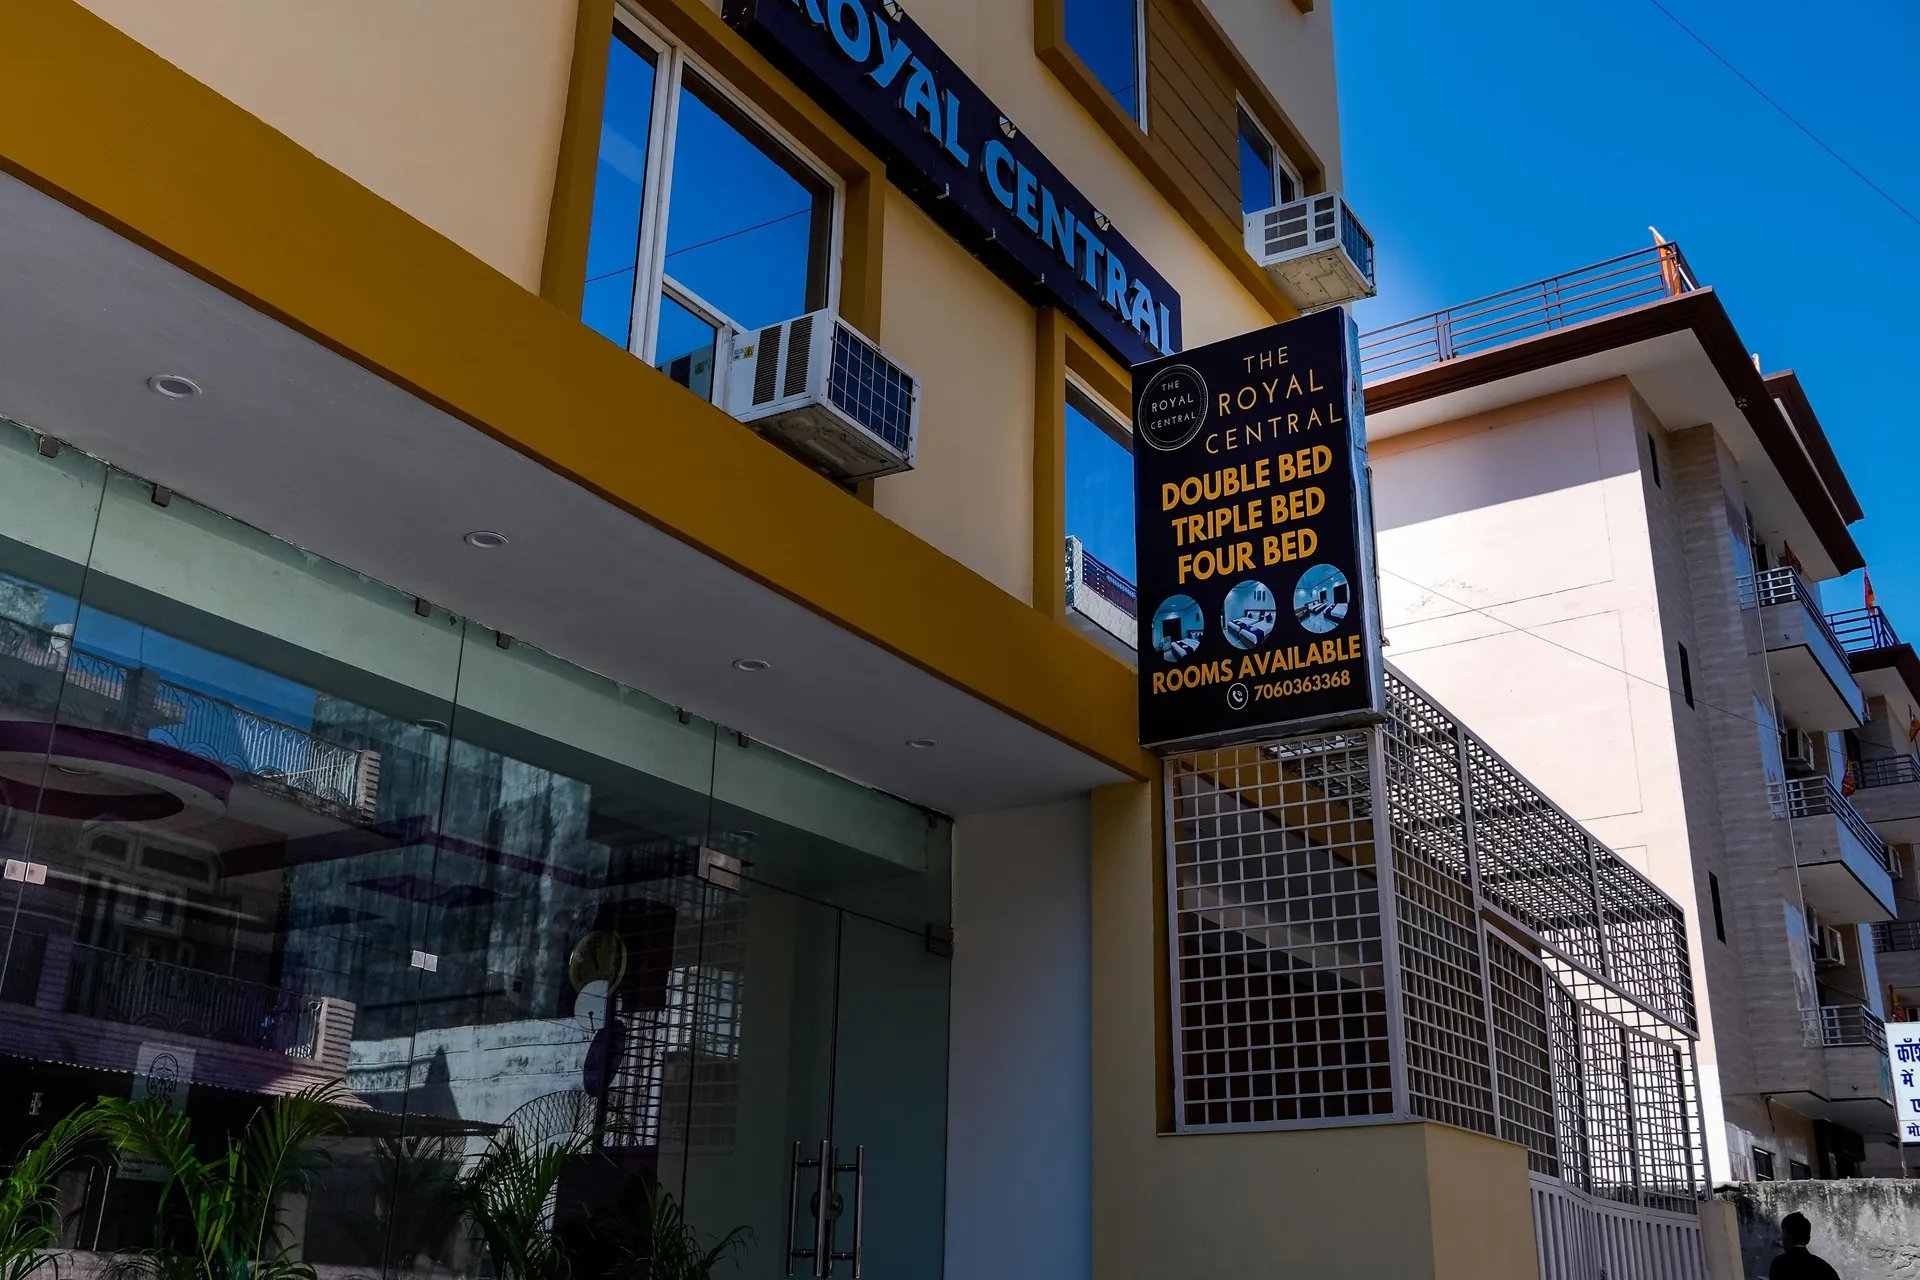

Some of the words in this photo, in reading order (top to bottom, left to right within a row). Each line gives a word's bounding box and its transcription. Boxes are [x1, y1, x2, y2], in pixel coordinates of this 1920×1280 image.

[984, 139, 1175, 357] CENTRAL
[1243, 345, 1288, 373] THE
[1151, 393, 1194, 413] ROYAL
[1161, 380, 1180, 391] THE
[1218, 368, 1324, 417] ROYAL
[1150, 411, 1197, 430] CENTRAL
[1205, 402, 1342, 454] CENTRAL
[1162, 458, 1271, 512] DOUBLE
[1278, 445, 1333, 483] BED
[1171, 499, 1263, 547] TRIPLE
[1271, 486, 1326, 525] BED
[1178, 541, 1257, 585] FOUR
[1263, 528, 1318, 567] BED
[1152, 658, 1234, 695] ROOMS
[1238, 635, 1362, 680] AVAILABLE
[1254, 669, 1351, 702] 7060363368
[1901, 1069, 1915, 1087] में
